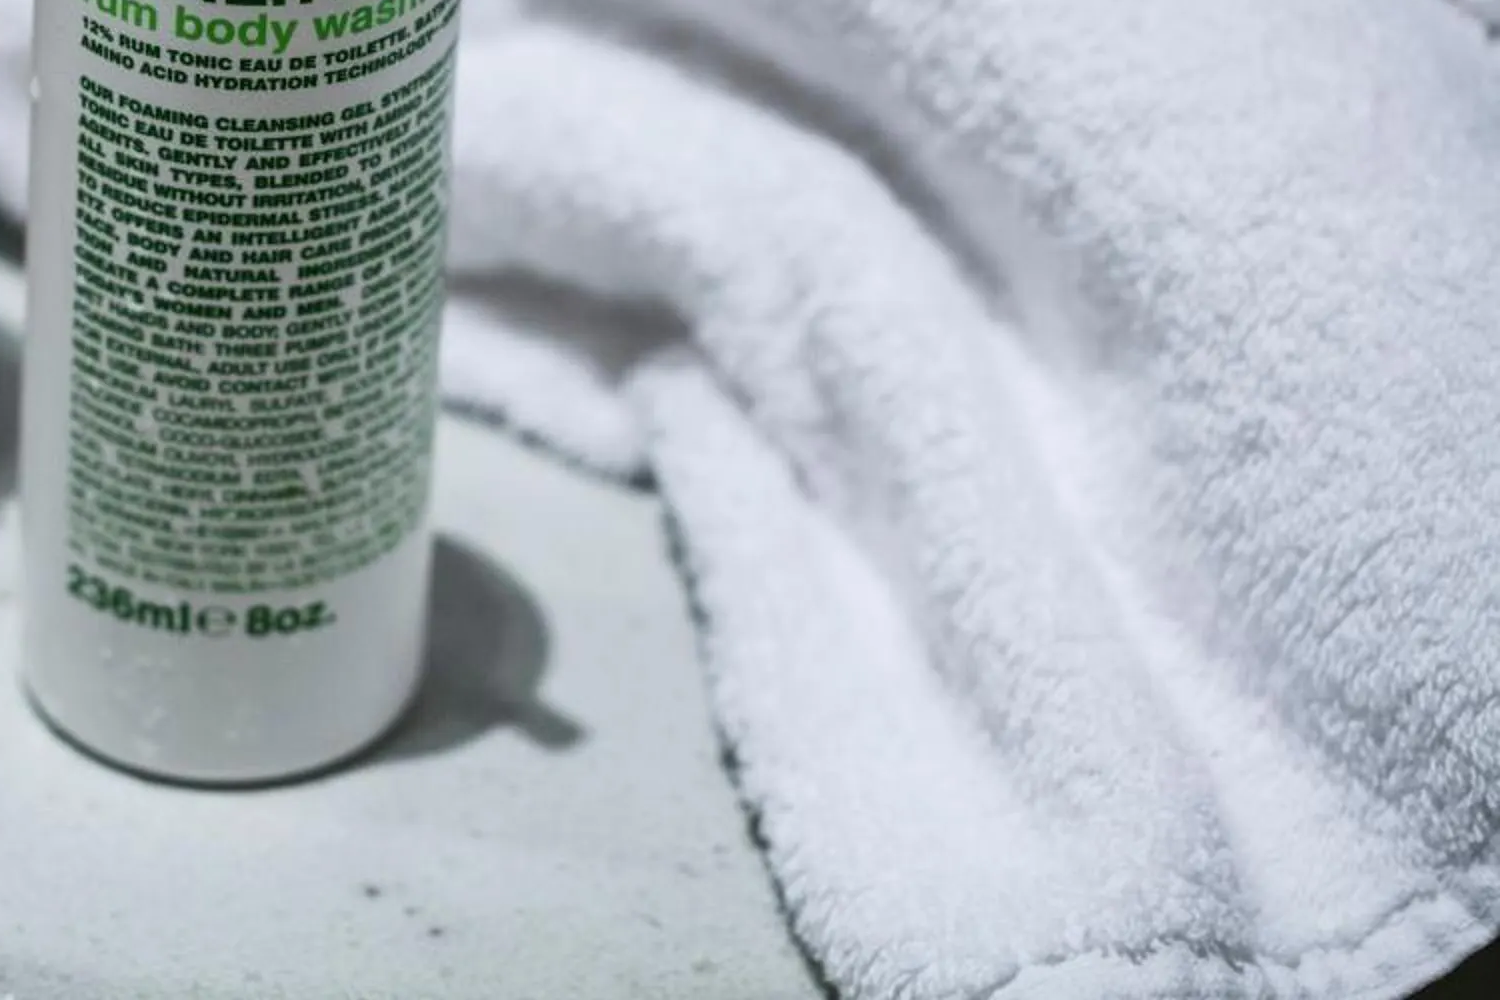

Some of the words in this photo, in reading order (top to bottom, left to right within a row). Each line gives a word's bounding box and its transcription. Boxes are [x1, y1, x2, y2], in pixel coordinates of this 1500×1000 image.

[81, 15, 115, 43] 12%
[118, 32, 161, 59] RUM
[166, 48, 233, 71] TONIC
[238, 57, 283, 72] EAU
[288, 56, 318, 71] DE
[174, 4, 299, 55] body
[80, 33, 136, 70] AMINO
[139, 61, 189, 85] ACID
[193, 73, 319, 92] HYDRATION
[78, 74, 114, 104] OUR
[117, 93, 209, 130] FOAMING
[215, 111, 335, 133] CLEANSING
[340, 101, 376, 122] GEL
[78, 92, 130, 130] TONIC
[134, 119, 175, 142] EAU
[179, 131, 209, 149] DE
[213, 135, 314, 152] TOILETTE
[319, 121, 368, 144] WITH
[78, 132, 108, 158] ALL
[114, 150, 160, 178] SKIN
[169, 166, 243, 191] TYPES,
[254, 164, 349, 190] BLENDED
[357, 153, 382, 172] TO
[157, 146, 239, 170] GENTLY
[243, 156, 291, 171] AND
[298, 117, 413, 168] EFFECTIVELY
[77, 150, 149, 194] RESIDUE
[152, 182, 246, 209] WITHOUT
[252, 179, 366, 209] IRRITATION,
[77, 167, 98, 191] TO
[101, 181, 180, 220] REDUCE
[182, 206, 304, 228] EPIDERMAL
[76, 187, 107, 216] ETZ
[111, 205, 185, 240] OFFERS
[190, 228, 223, 244] AN
[231, 214, 362, 247] INTELLIGENT
[366, 197, 402, 225] AND
[74, 243, 140, 286] CREATE
[145, 275, 160, 291] A
[165, 279, 280, 303] COMPLETE
[287, 272, 356, 300] RANGE
[126, 231, 182, 259] BODY
[188, 247, 234, 265] AND
[240, 249, 294, 266] HAIR
[300, 236, 353, 261] CARE
[126, 251, 169, 274] AND
[182, 263, 281, 283] NATURAL
[152, 295, 233, 322] WOMEN
[240, 305, 288, 321] AND
[173, 319, 217, 339] AND
[284, 309, 353, 338] GENTLY
[206, 359, 268, 377] ADULT
[273, 358, 312, 375] USE
[213, 340, 278, 359] THREE
[216, 375, 310, 396] CONTACT
